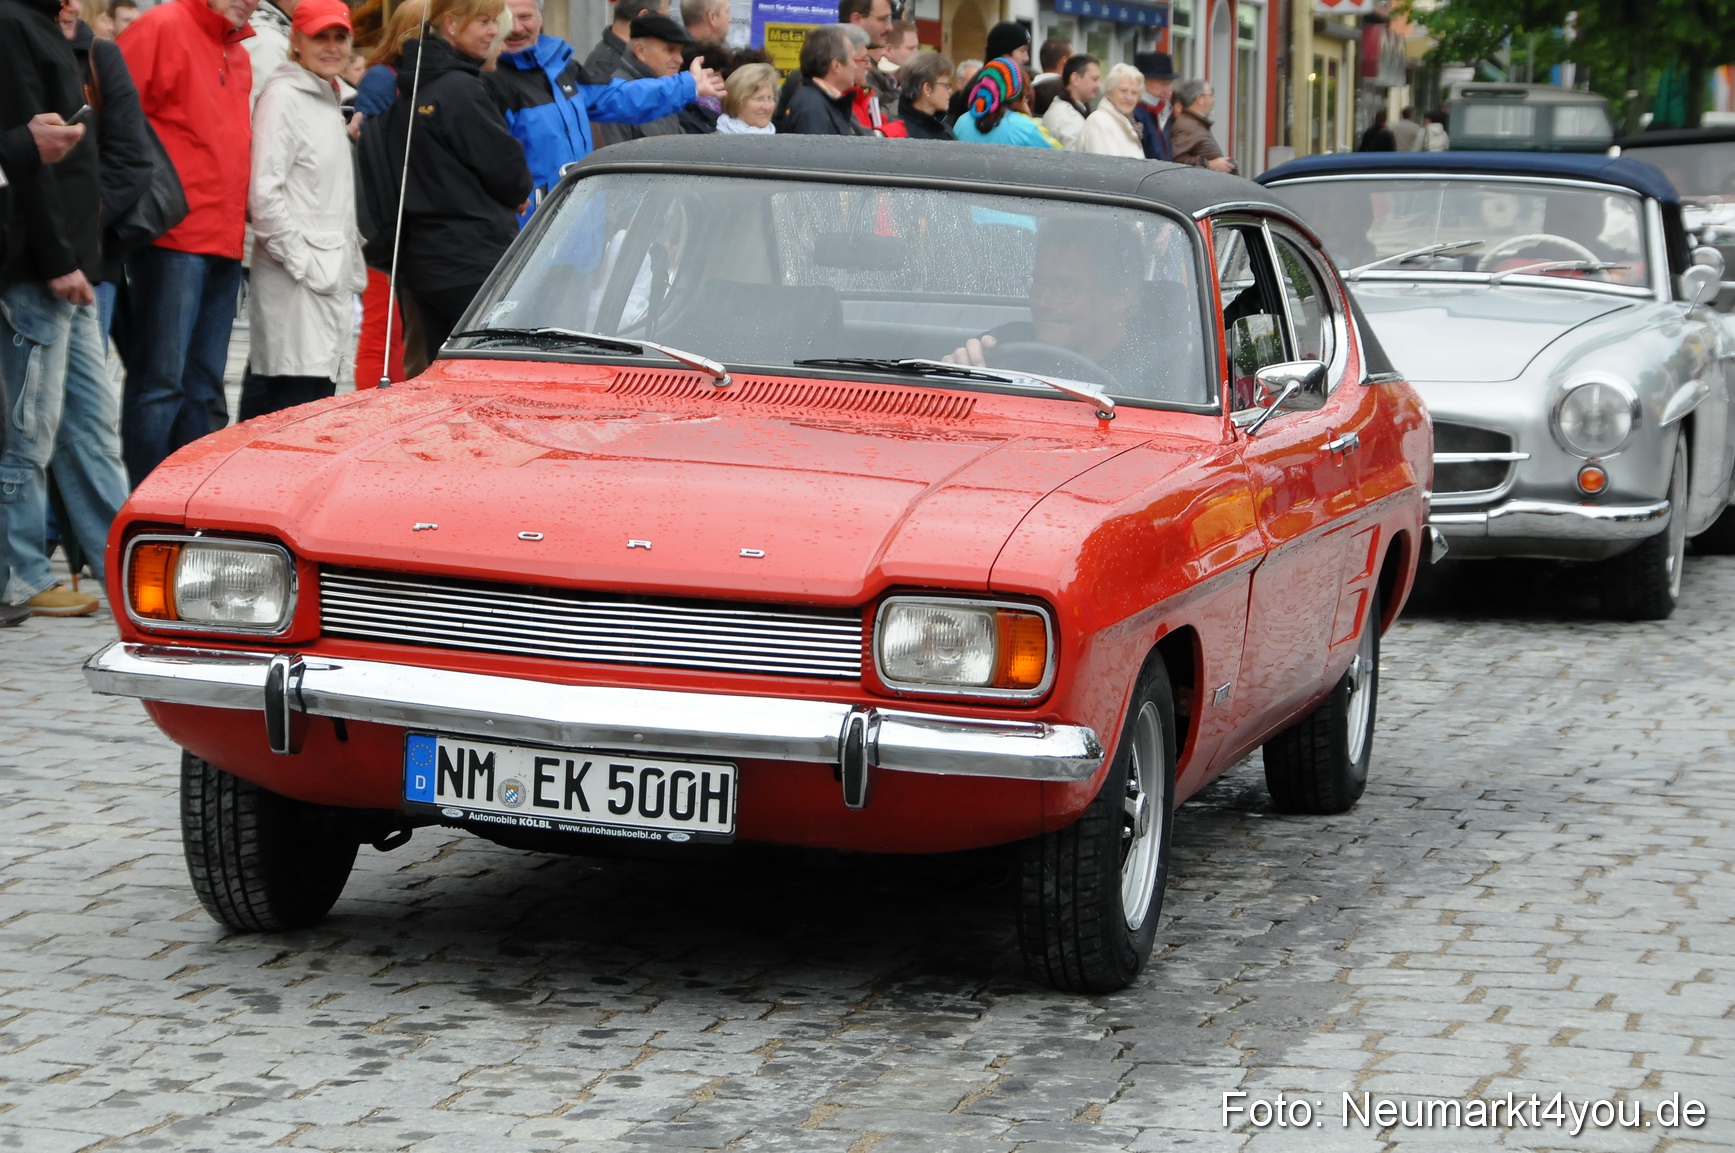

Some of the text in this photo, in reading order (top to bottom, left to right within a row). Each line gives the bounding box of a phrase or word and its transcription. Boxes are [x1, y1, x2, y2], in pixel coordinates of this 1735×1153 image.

[415, 775, 426, 790] D
[437, 745, 495, 802] NM
[533, 756, 593, 812] EK
[607, 763, 729, 824] 500H
[468, 811, 517, 825] Automobile
[519, 817, 552, 829] KÖLBL
[558, 823, 662, 840] www.autohauskoelbl.de
